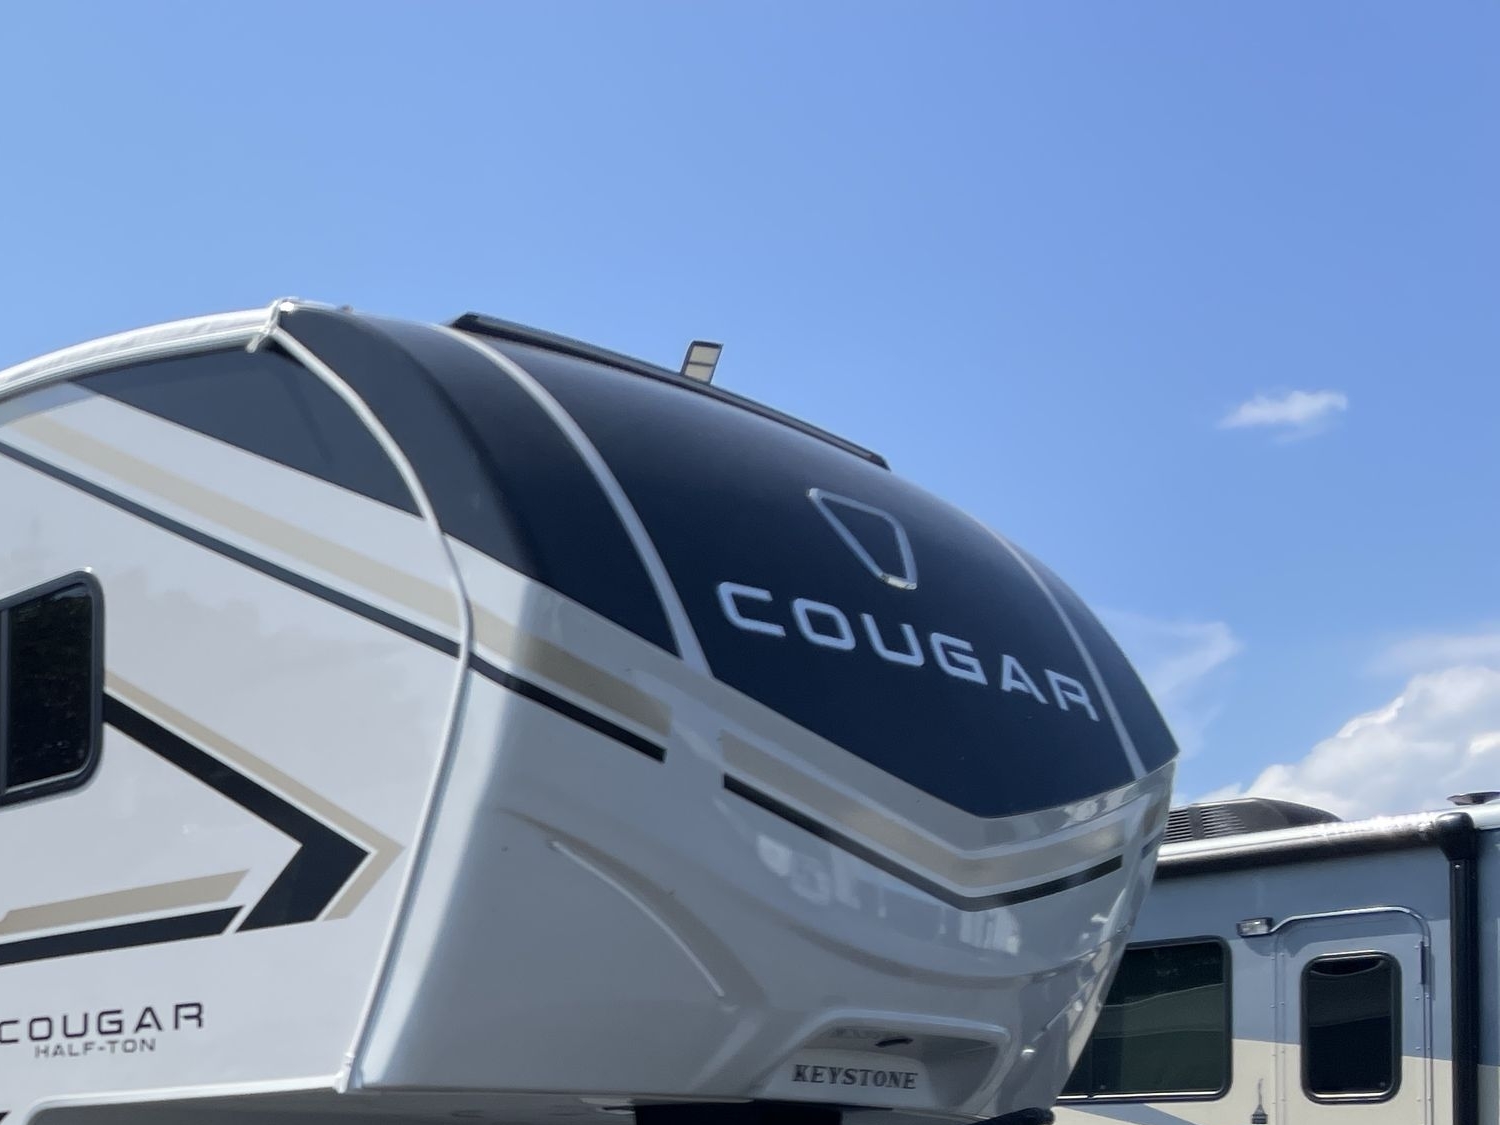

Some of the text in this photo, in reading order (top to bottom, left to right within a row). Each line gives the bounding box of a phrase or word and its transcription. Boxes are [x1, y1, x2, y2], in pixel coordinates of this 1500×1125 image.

[717, 581, 1100, 722] COUGAR
[34, 1038, 157, 1058] HALF-TON
[792, 1064, 918, 1090] KEYSTONE
